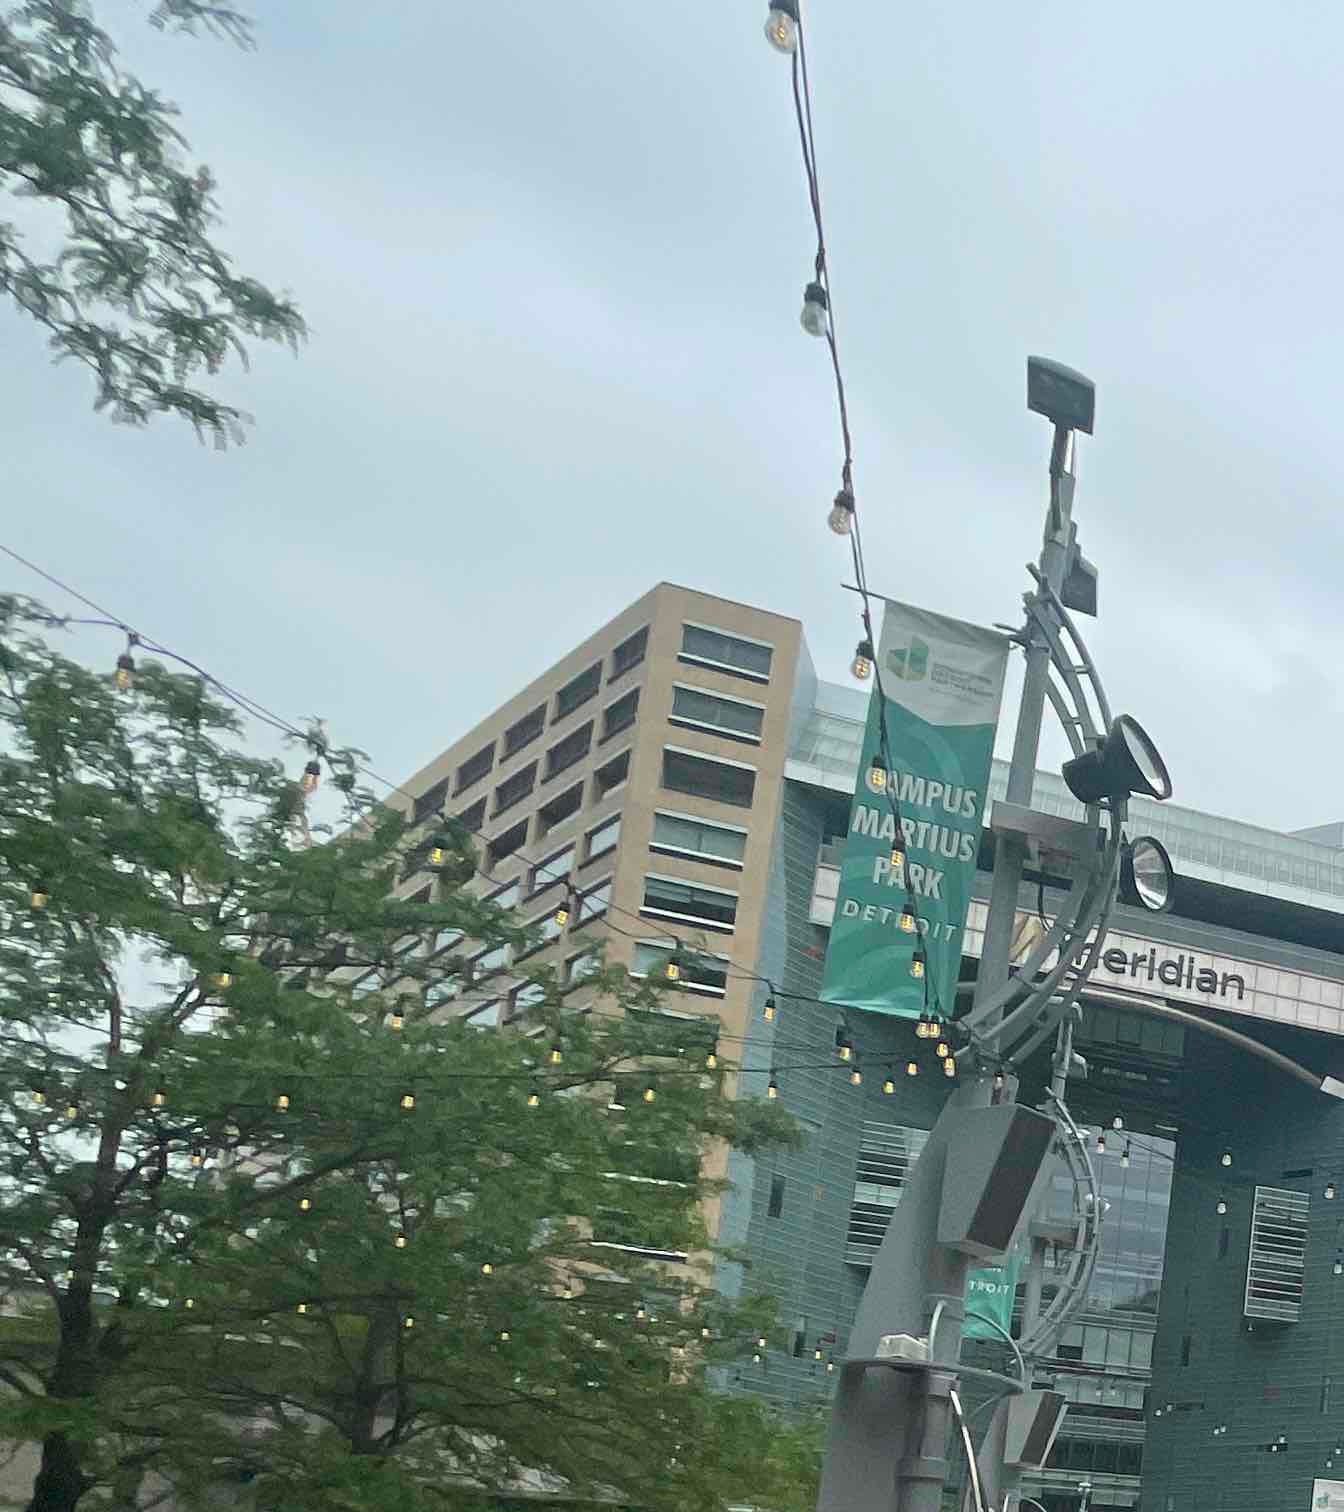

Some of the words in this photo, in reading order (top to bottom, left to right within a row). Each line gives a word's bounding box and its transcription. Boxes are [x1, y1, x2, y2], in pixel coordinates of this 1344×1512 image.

[852, 805, 976, 862] MARTIUS
[873, 856, 945, 900] PARK
[841, 899, 957, 943] DETOIT
